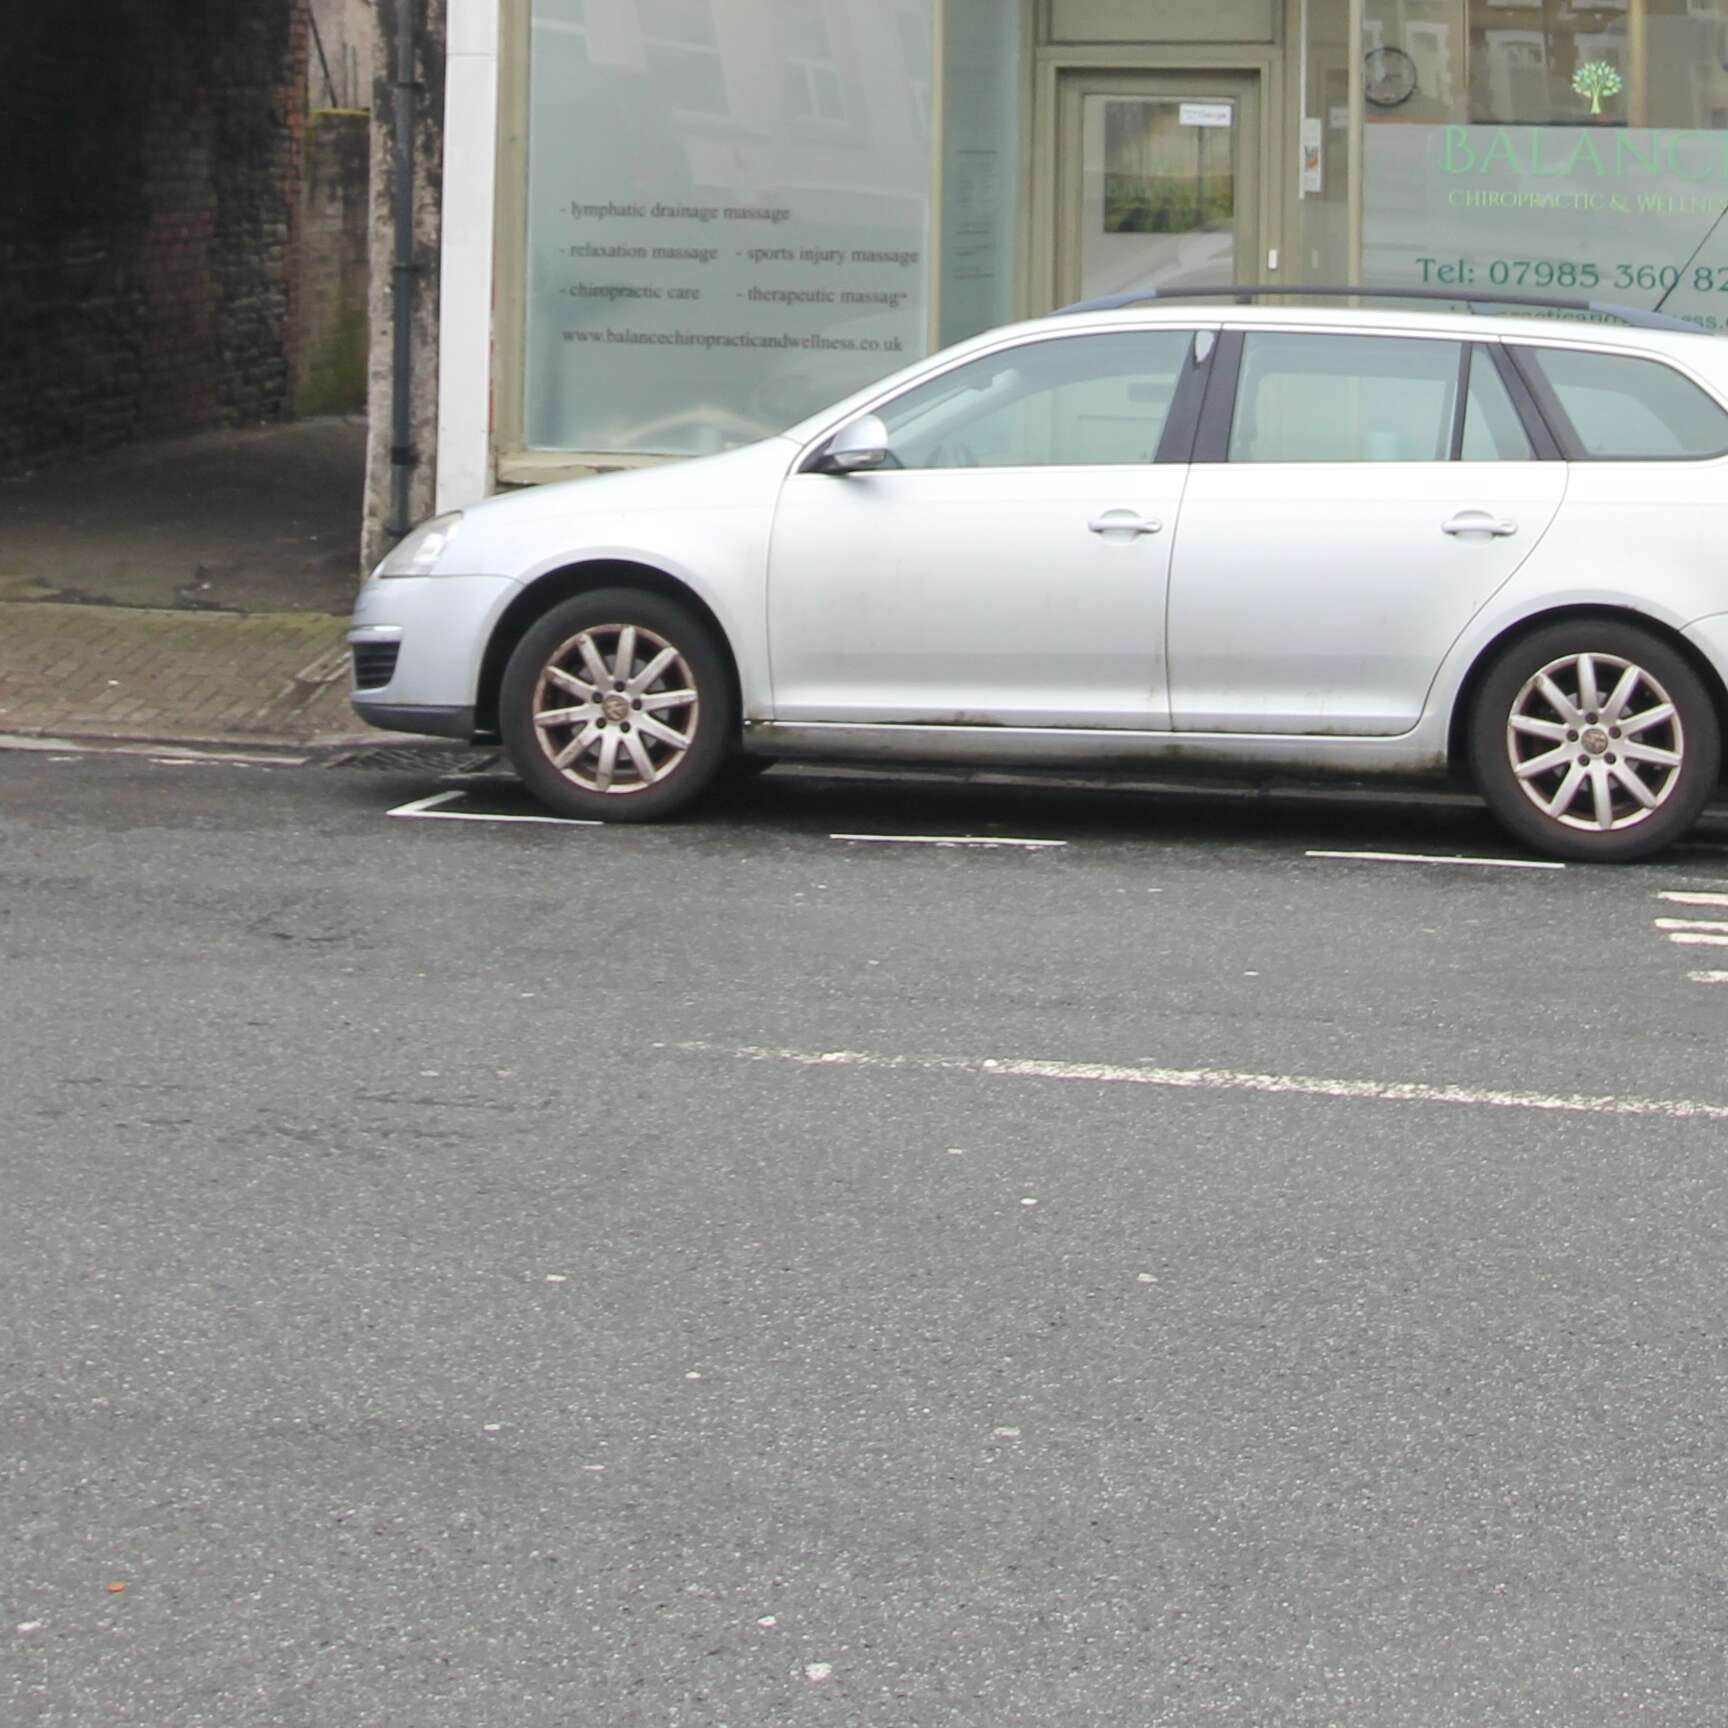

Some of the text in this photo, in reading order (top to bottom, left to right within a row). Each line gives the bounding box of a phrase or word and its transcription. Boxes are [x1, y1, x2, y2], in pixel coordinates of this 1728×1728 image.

[1447, 189, 1603, 209] CHIROPRACTIC
[570, 200, 646, 221] lymphatic
[650, 201, 719, 223] drainage
[723, 206, 791, 224] massage
[570, 241, 648, 259] relaxation
[652, 245, 719, 264] massage
[747, 247, 795, 265] sports
[798, 245, 844, 266] injury
[850, 248, 920, 267] massage
[1415, 257, 1474, 285] Tel:
[1489, 259, 1601, 289] 07985
[1614, 263, 1680, 290] 360
[569, 281, 663, 302] chiropractic
[666, 286, 701, 301] care
[747, 285, 835, 306] therapeutic
[561, 327, 904, 353] www.balancechiropracticandwellness.co.uk
